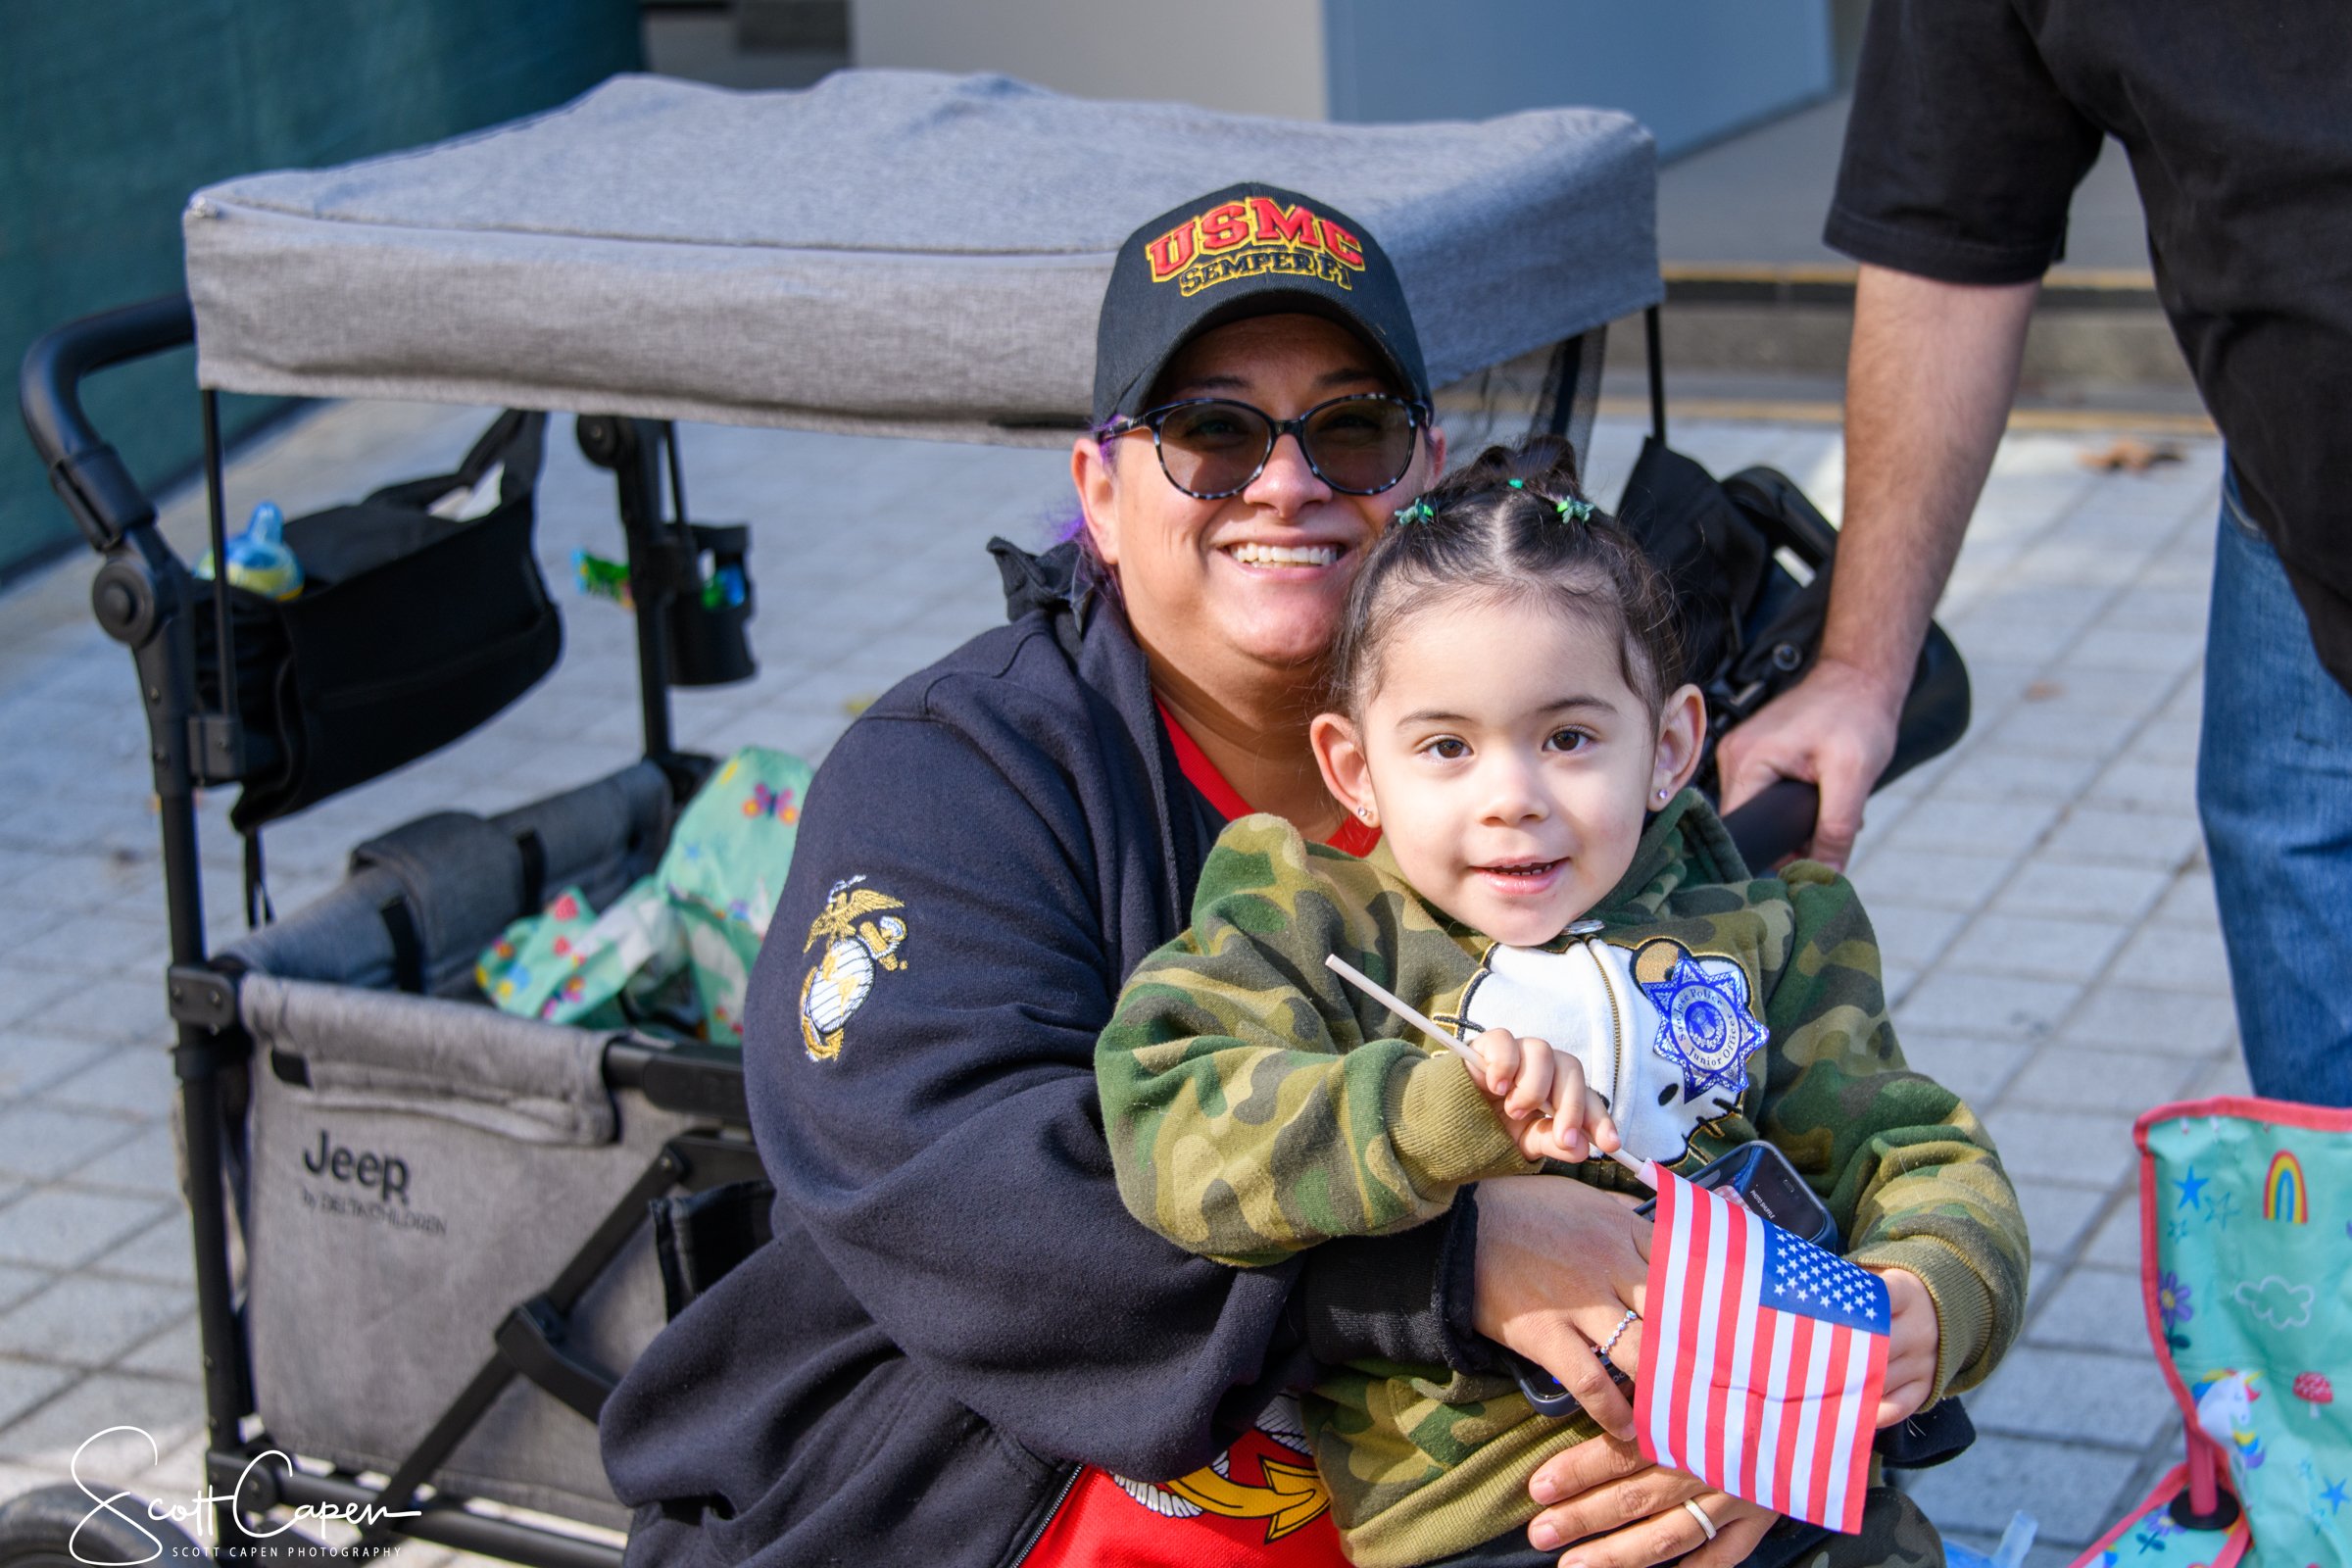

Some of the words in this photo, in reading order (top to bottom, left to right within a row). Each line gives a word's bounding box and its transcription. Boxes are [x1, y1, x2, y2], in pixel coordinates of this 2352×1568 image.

[1146, 196, 1365, 282] USMC
[1179, 250, 1317, 297] SEMPER
[1315, 253, 1352, 290] FI
[1677, 1017, 1686, 1042] San
[1690, 988, 1723, 1006] Police
[1686, 1048, 1722, 1066] Junior
[1722, 1012, 1737, 1058] Officer
[303, 1129, 410, 1202] Jeep
[1749, 1189, 1763, 1204] PHOTO
[1760, 1201, 1776, 1219] SHUFFLE
